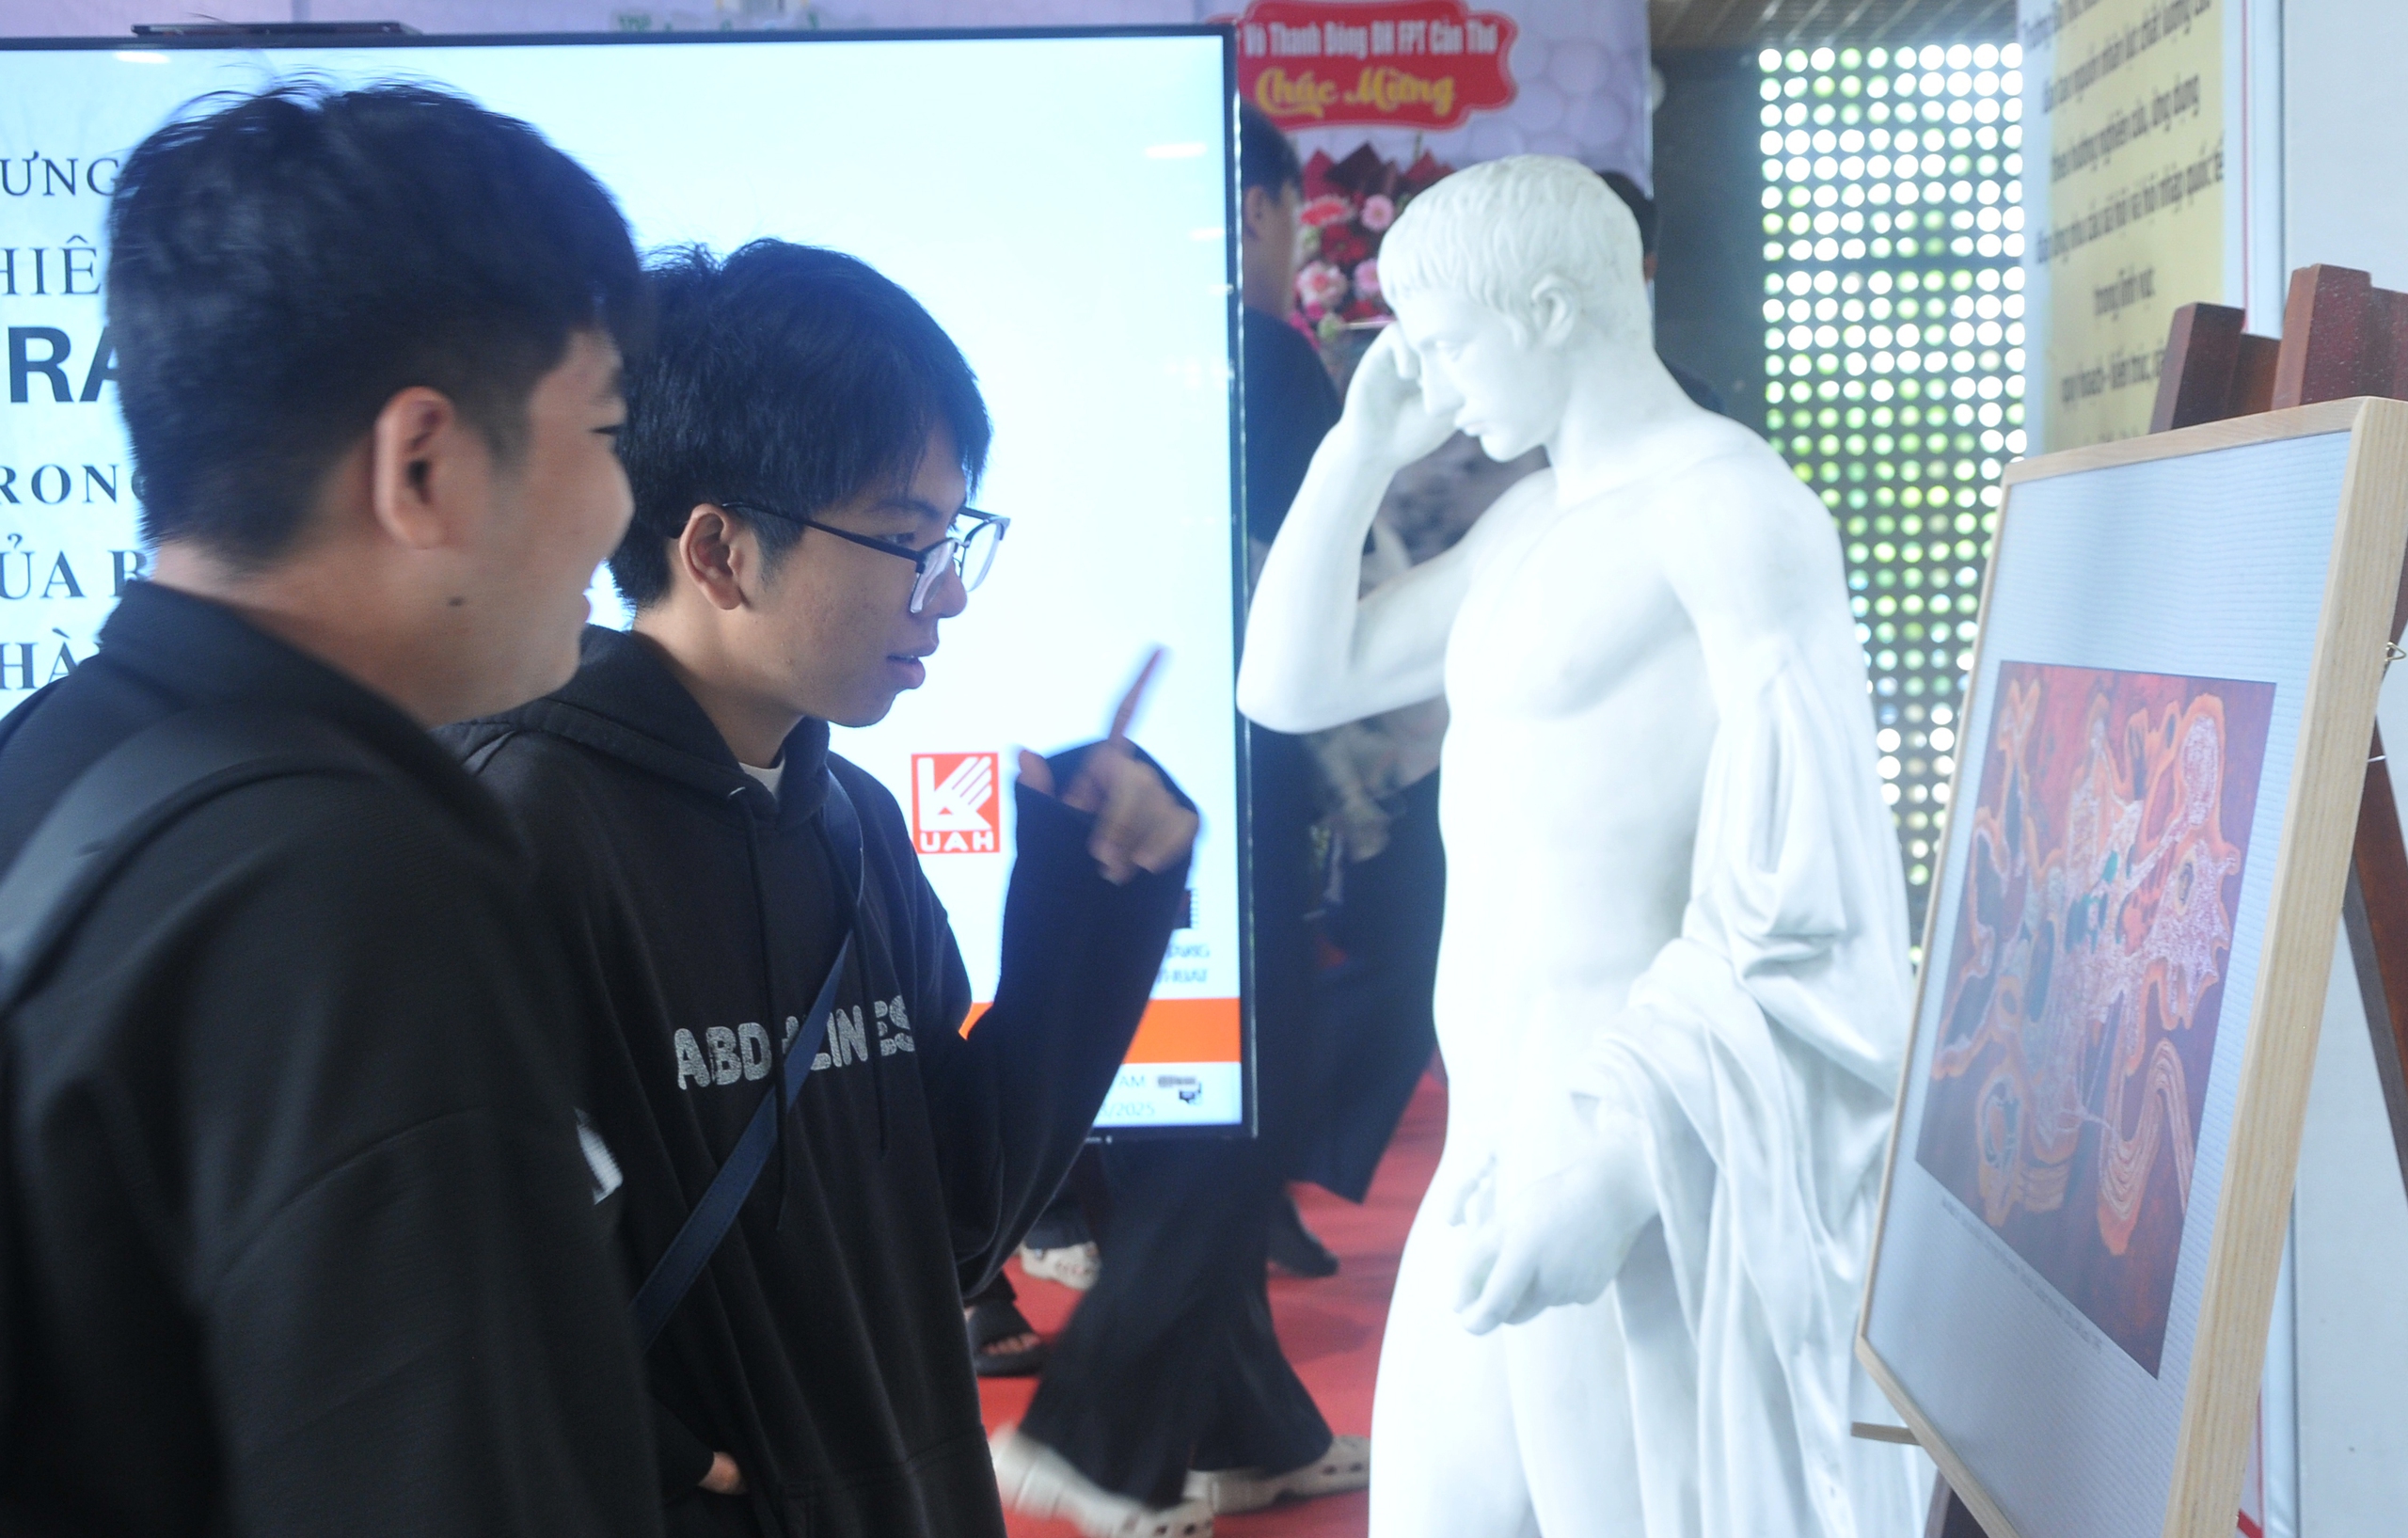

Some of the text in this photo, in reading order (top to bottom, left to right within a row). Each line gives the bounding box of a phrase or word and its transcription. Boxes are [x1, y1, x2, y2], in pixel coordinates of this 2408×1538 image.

[1271, 22, 1322, 55] Thanh
[1398, 20, 1426, 55] FPT
[1256, 67, 1454, 117] Chúc Mừng
[0, 464, 145, 505] RON
[920, 831, 994, 852] UAH
[1119, 1075, 1146, 1087] AM
